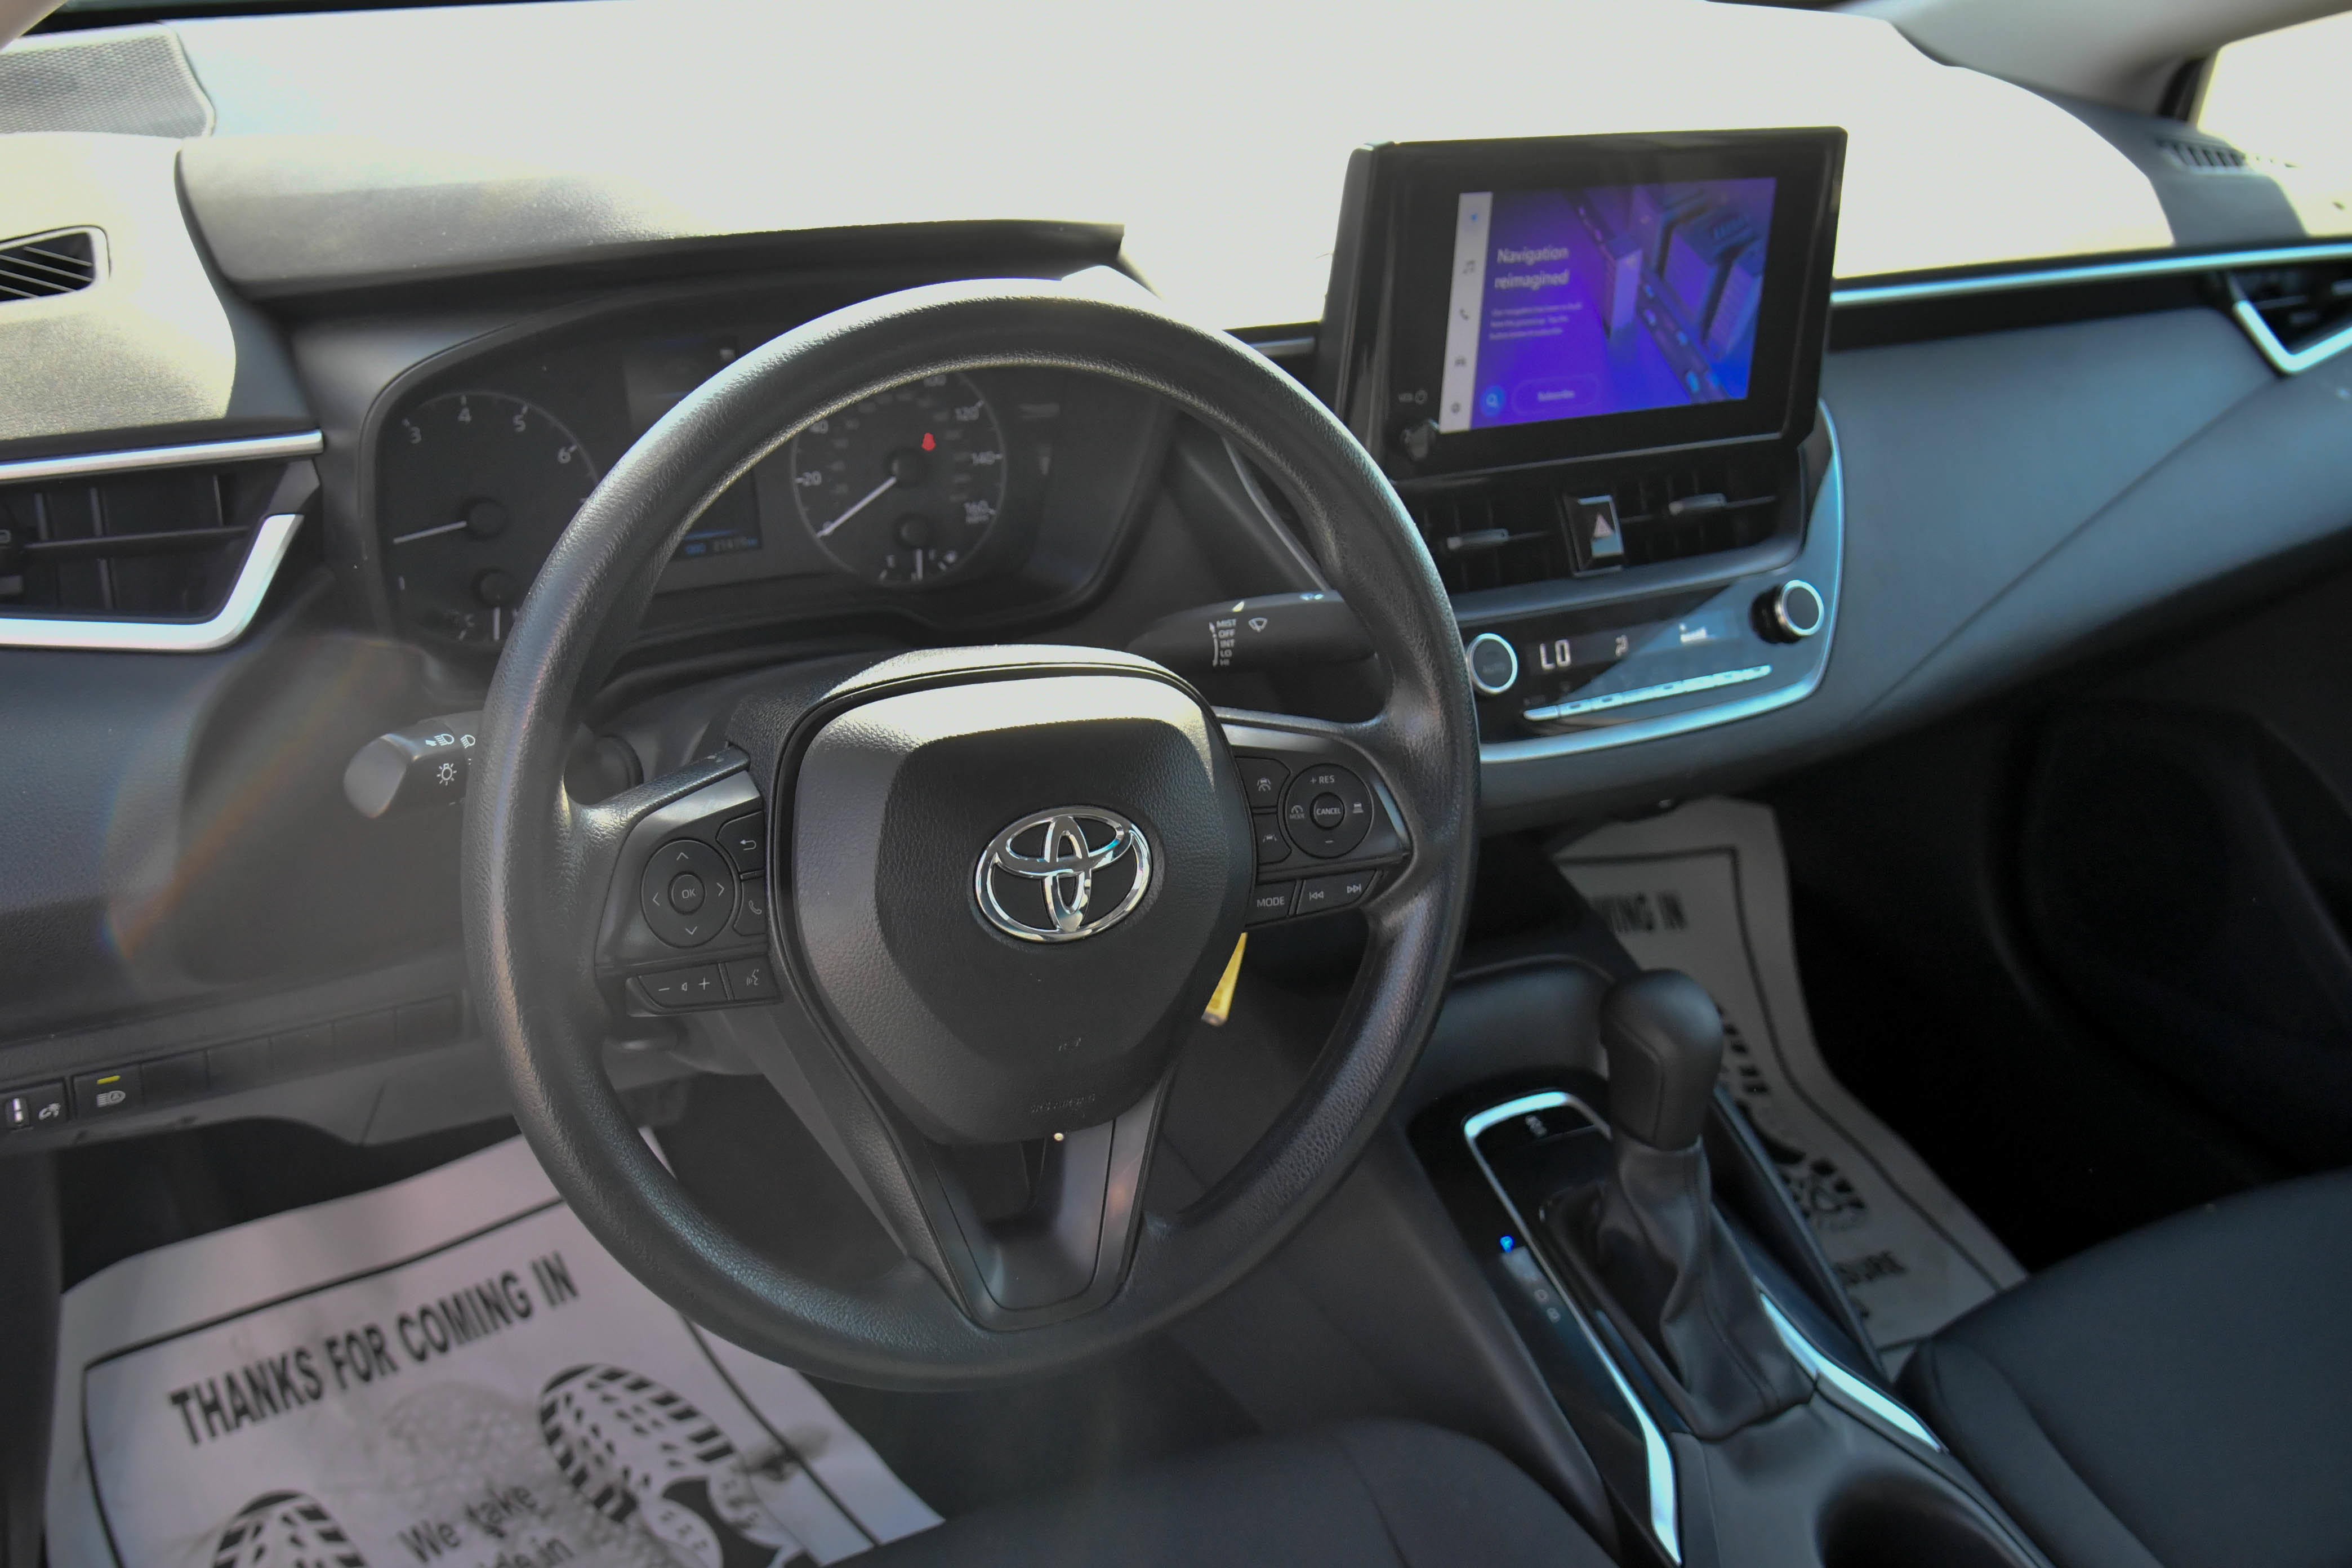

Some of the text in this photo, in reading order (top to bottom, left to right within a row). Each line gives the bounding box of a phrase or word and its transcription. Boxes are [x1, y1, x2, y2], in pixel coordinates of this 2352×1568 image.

[1496, 244, 1569, 266] Navigation
[1495, 269, 1570, 291] reimagined
[457, 407, 471, 423] 4
[512, 415, 526, 433] 5
[409, 426, 422, 444] 3
[557, 446, 572, 464] 6
[803, 471, 822, 487] 20
[1217, 619, 1236, 628] MIST
[1218, 629, 1235, 639] OFF
[1220, 639, 1235, 648] INT
[1220, 649, 1232, 658] LO
[1539, 639, 1571, 670] LO
[1318, 775, 1335, 784] RES
[1316, 807, 1342, 816] CANCEL
[681, 888, 696, 899] OK
[1257, 896, 1285, 908] MODE
[168, 1250, 580, 1446] THANKS FOR COMING IN
[397, 1519, 461, 1564] We
